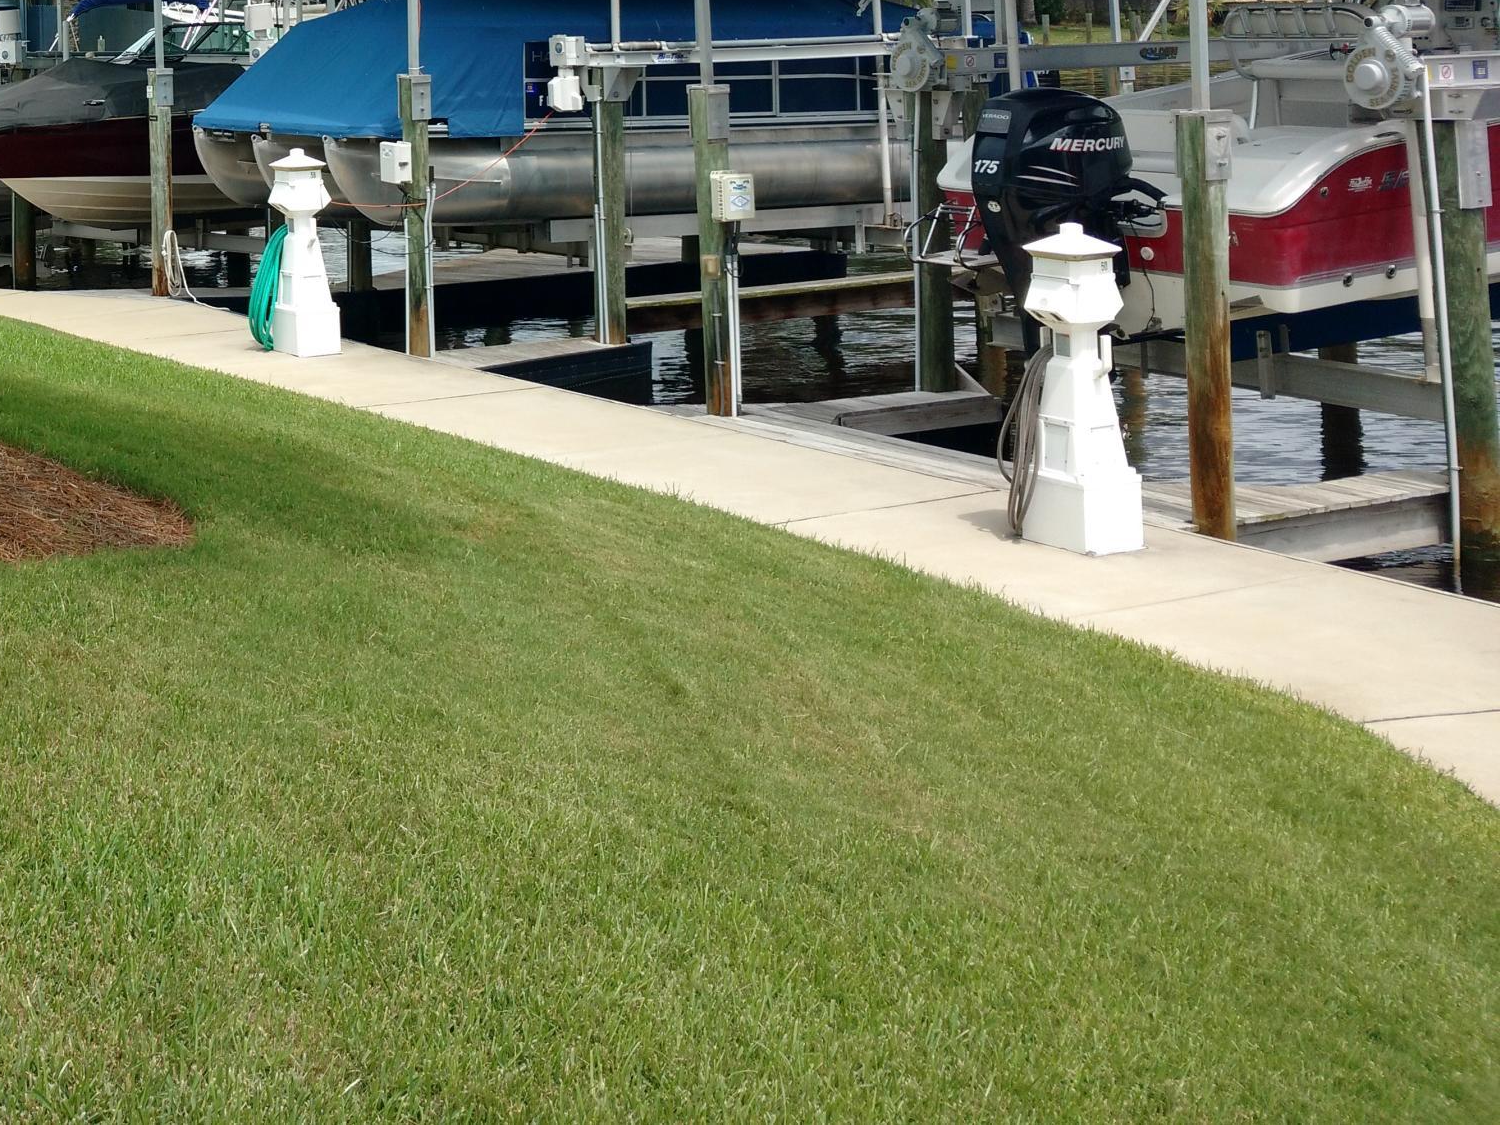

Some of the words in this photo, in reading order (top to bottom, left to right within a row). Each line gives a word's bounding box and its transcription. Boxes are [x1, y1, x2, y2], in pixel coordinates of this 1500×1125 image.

[1346, 47, 1376, 83] GOLDEN
[1050, 135, 1125, 152] MERCURY
[974, 159, 1000, 174] 175
